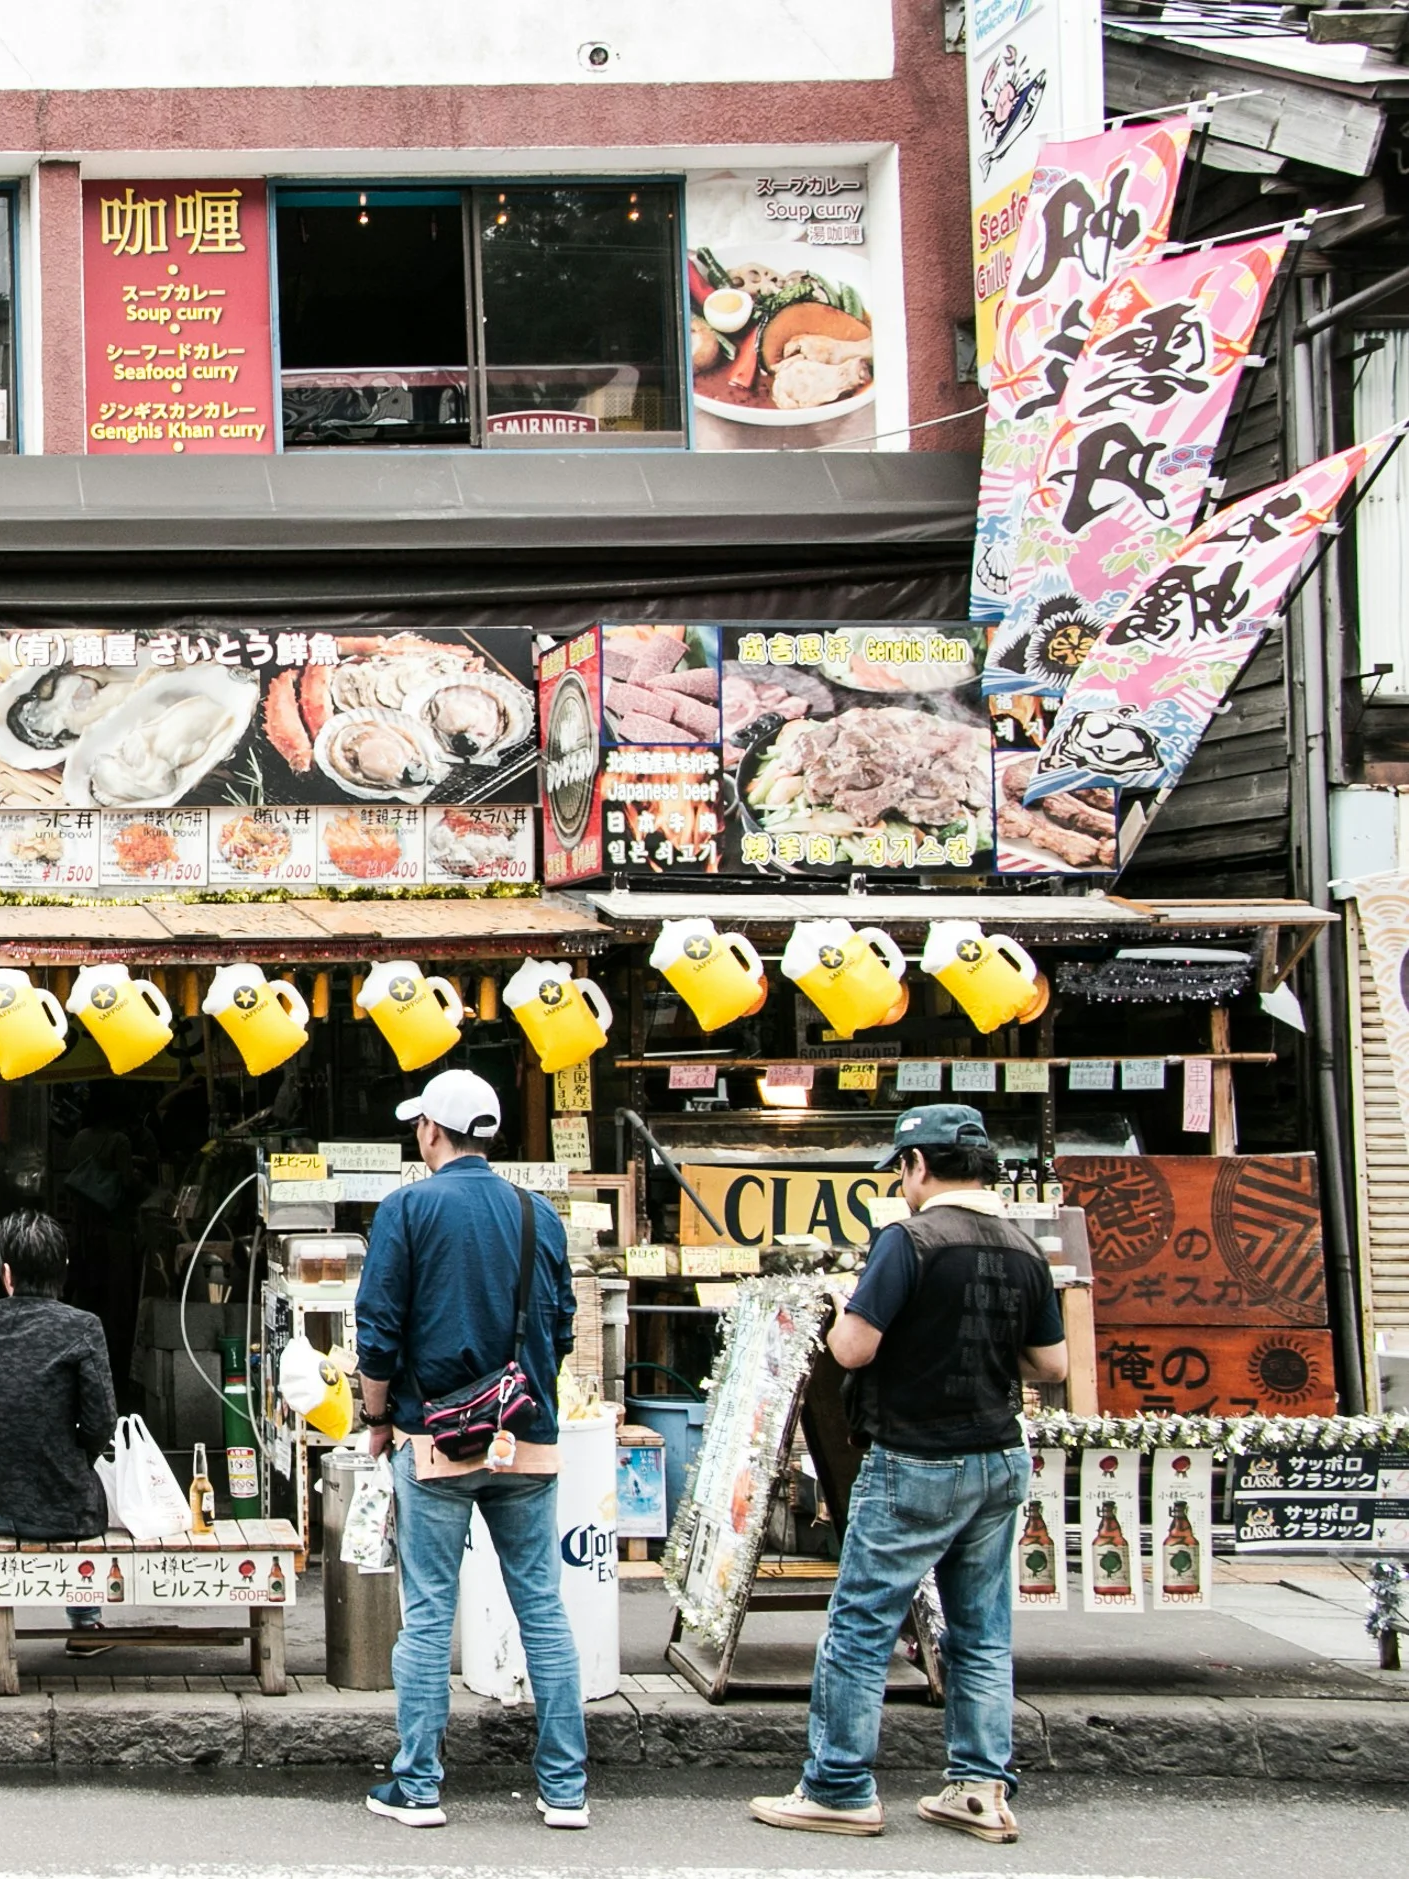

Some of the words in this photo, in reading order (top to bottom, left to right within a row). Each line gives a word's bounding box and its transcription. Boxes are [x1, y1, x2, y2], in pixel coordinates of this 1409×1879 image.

[755, 176, 861, 197] スープカレー
[764, 200, 812, 223] Soup
[814, 202, 863, 224] curry
[975, 243, 1014, 302] Grille
[122, 284, 226, 303] スープカレー
[126, 305, 172, 325] Soup
[176, 306, 223, 325] curry
[105, 343, 246, 362] シーフードカレー
[113, 363, 188, 381] Seafood
[192, 365, 239, 384] curry
[98, 402, 257, 421] ジンギスカンカレー
[90, 421, 163, 443] Genghis
[168, 421, 215, 440] Khan
[219, 422, 266, 442] curry
[149, 631, 343, 668] さいとう鮮魚
[864, 637, 924, 666] Genghis
[927, 638, 968, 664] Khan
[607, 780, 679, 803] Japanese
[681, 779, 719, 801] beef
[35, 810, 94, 830] うに丼
[35, 830, 55, 839] uni
[58, 829, 93, 840] bowl
[172, 828, 202, 838] bowl
[607, 840, 649, 865] 일본
[41, 865, 93, 883] ¥1,500
[150, 863, 202, 882] ¥1,500
[262, 863, 312, 879] ¥1,000
[367, 862, 418, 878] ¥1,400
[273, 1155, 321, 1169] 生ビール
[1096, 1271, 1270, 1307] ンギスカン
[1098, 1341, 1211, 1391] 俺の
[1288, 1454, 1363, 1472] サッポロ
[1240, 1474, 1285, 1488] CLASSIC
[1287, 1472, 1376, 1488] クラシック
[1284, 1503, 1359, 1521] サッポロ
[1240, 1524, 1282, 1538] CLASSIC
[1283, 1522, 1371, 1538] クラシック
[561, 1523, 616, 1570] Cor
[139, 1556, 231, 1576] 小樽ビール
[65, 1590, 105, 1604] 500円
[152, 1578, 251, 1599] ピルスナー
[229, 1590, 269, 1603] 500円
[1162, 1592, 1203, 1604] 500円
[1019, 1593, 1061, 1604] 500円
[1094, 1594, 1137, 1606] 500円
